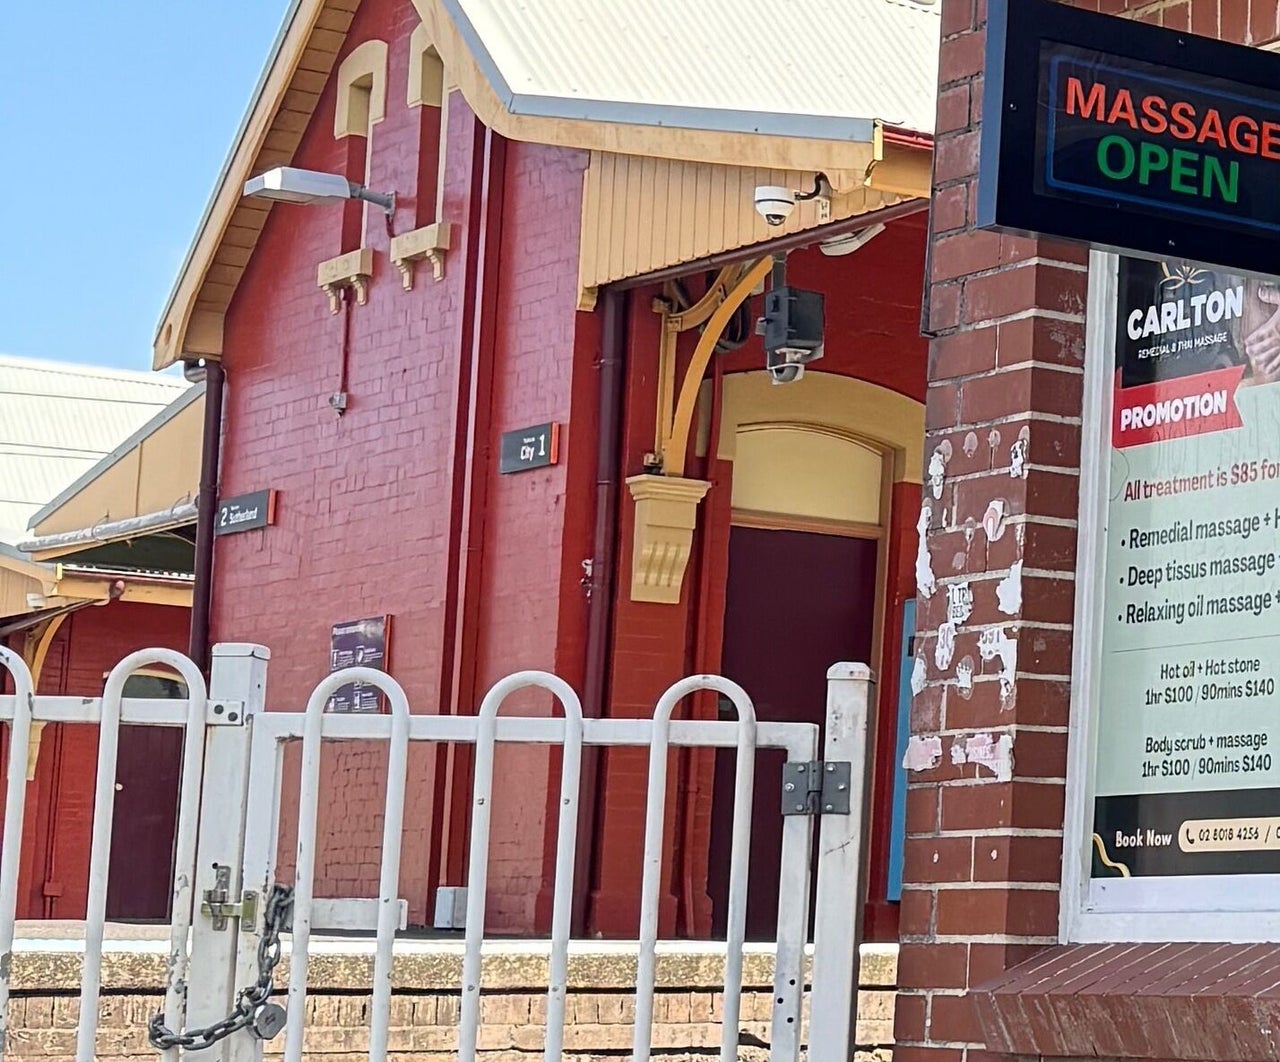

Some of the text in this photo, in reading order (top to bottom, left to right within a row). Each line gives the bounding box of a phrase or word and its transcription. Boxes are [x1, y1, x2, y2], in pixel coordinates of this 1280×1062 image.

[1097, 135, 1239, 203] OPEN
[1127, 286, 1243, 340] CARLTON
[1138, 343, 1170, 359] REMEDIAL
[1194, 331, 1228, 348] MASSAGE
[1120, 390, 1228, 431] PROMOTION
[538, 434, 545, 456] 1
[1125, 480, 1140, 502] All
[1143, 470, 1214, 499] treatment
[1217, 468, 1227, 487] is
[1231, 460, 1258, 485] $85
[221, 507, 227, 526] 2
[1129, 520, 1193, 549] Remedial
[1196, 512, 1260, 543] massage
[1128, 563, 1163, 588] Deep
[1166, 559, 1207, 583] tissus
[1210, 550, 1275, 577] massage
[1126, 597, 1185, 624] Relaxing
[1188, 594, 1204, 617] oil
[1206, 590, 1271, 619] massage
[1160, 663, 1180, 680] Hot
[1182, 660, 1195, 678] oil
[1205, 659, 1225, 676] Hot
[1228, 657, 1260, 673] stone
[1145, 688, 1162, 706] 1hr
[1201, 680, 1243, 700] 90mins
[1145, 736, 1173, 757] Body
[1174, 732, 1206, 752] scrub
[1216, 731, 1268, 751] massage
[1141, 761, 1159, 778] 1hr
[1198, 755, 1240, 775] 90mins
[1115, 828, 1143, 848] Book
[1146, 829, 1172, 847] Now
[1213, 827, 1234, 842] 8018
[1236, 826, 1259, 841] 4256
